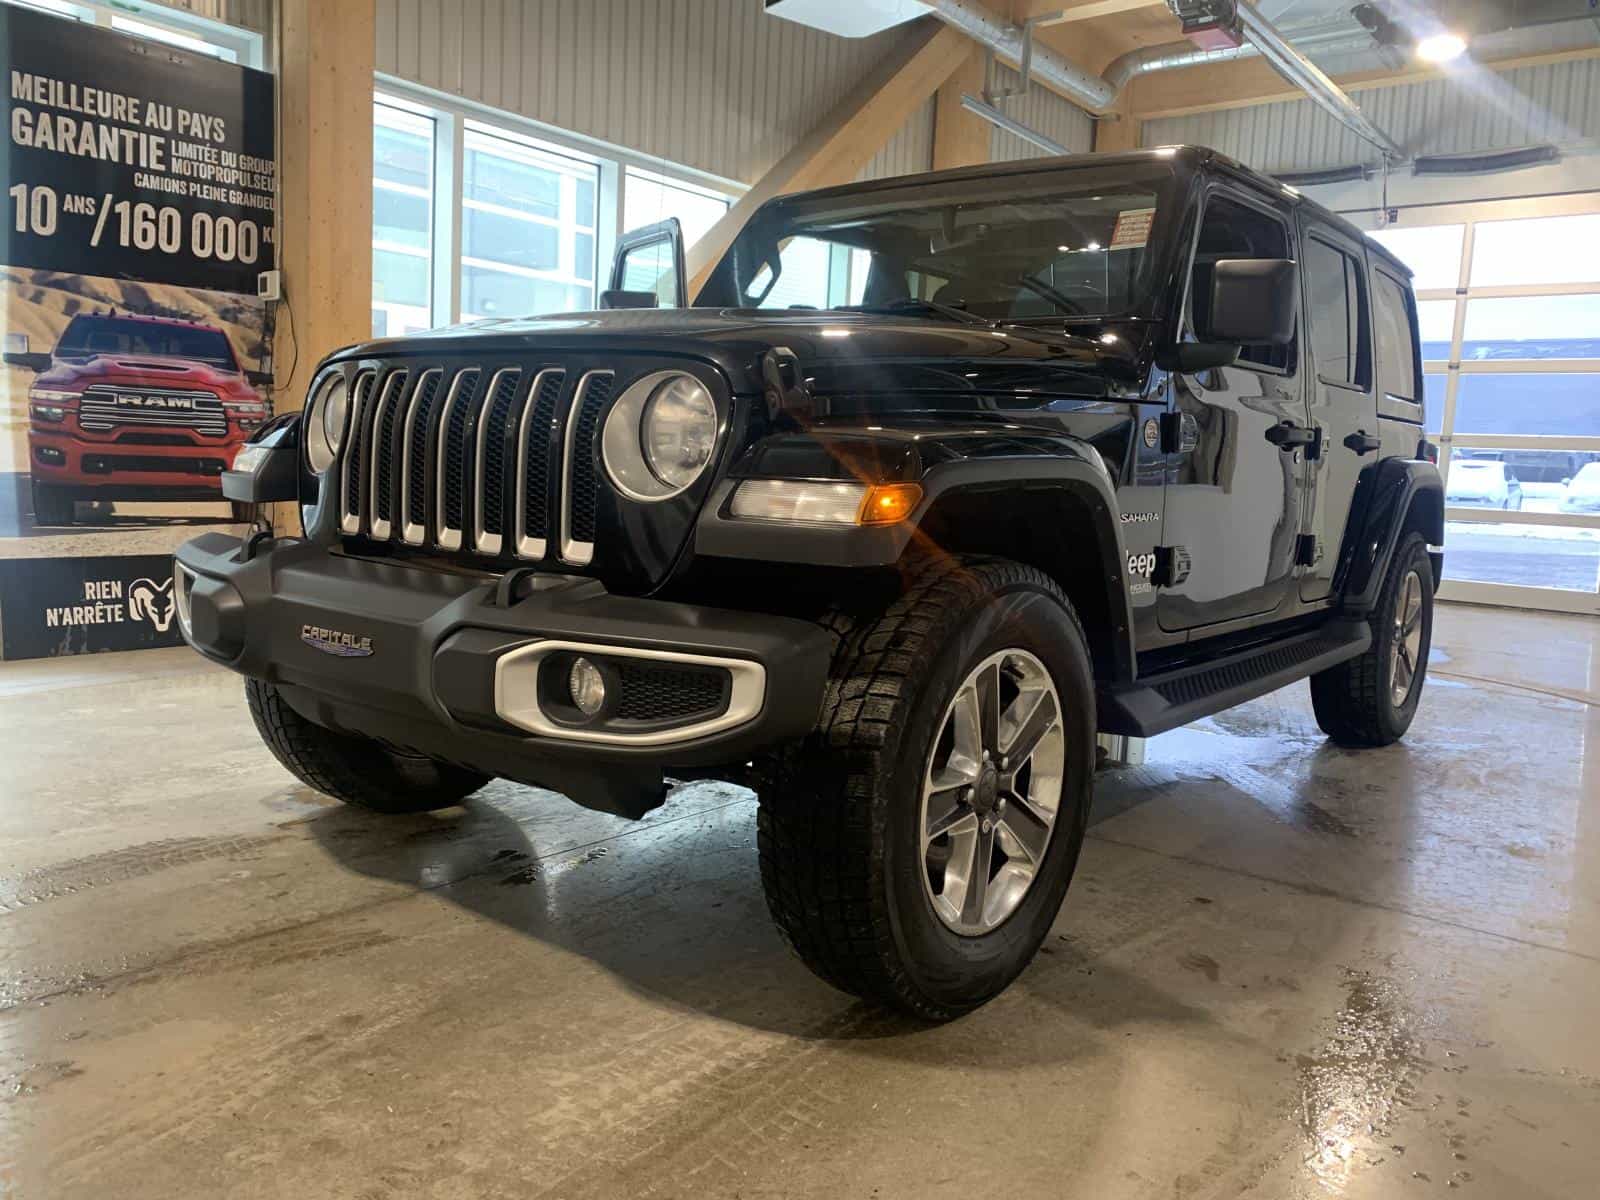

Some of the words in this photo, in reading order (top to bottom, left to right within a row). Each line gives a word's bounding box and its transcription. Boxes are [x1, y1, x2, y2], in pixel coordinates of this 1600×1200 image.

[11, 70, 141, 125] MEILLEURE
[145, 102, 172, 132] AU
[178, 109, 225, 144] PAYS
[11, 107, 166, 172] GARANTIE
[171, 139, 219, 164] LIMITÉE
[221, 150, 237, 168] DU
[134, 172, 187, 195] CAMIONS
[189, 182, 228, 203] PLEINE
[10, 183, 57, 237] 10
[63, 193, 96, 216] ANS
[191, 212, 258, 264] 000
[118, 394, 192, 409] RAM
[1120, 512, 1160, 523] SAHARA
[84, 580, 122, 600] RIEN
[46, 600, 124, 627] N'ARRÊTE
[301, 624, 372, 651] CAPITALE
